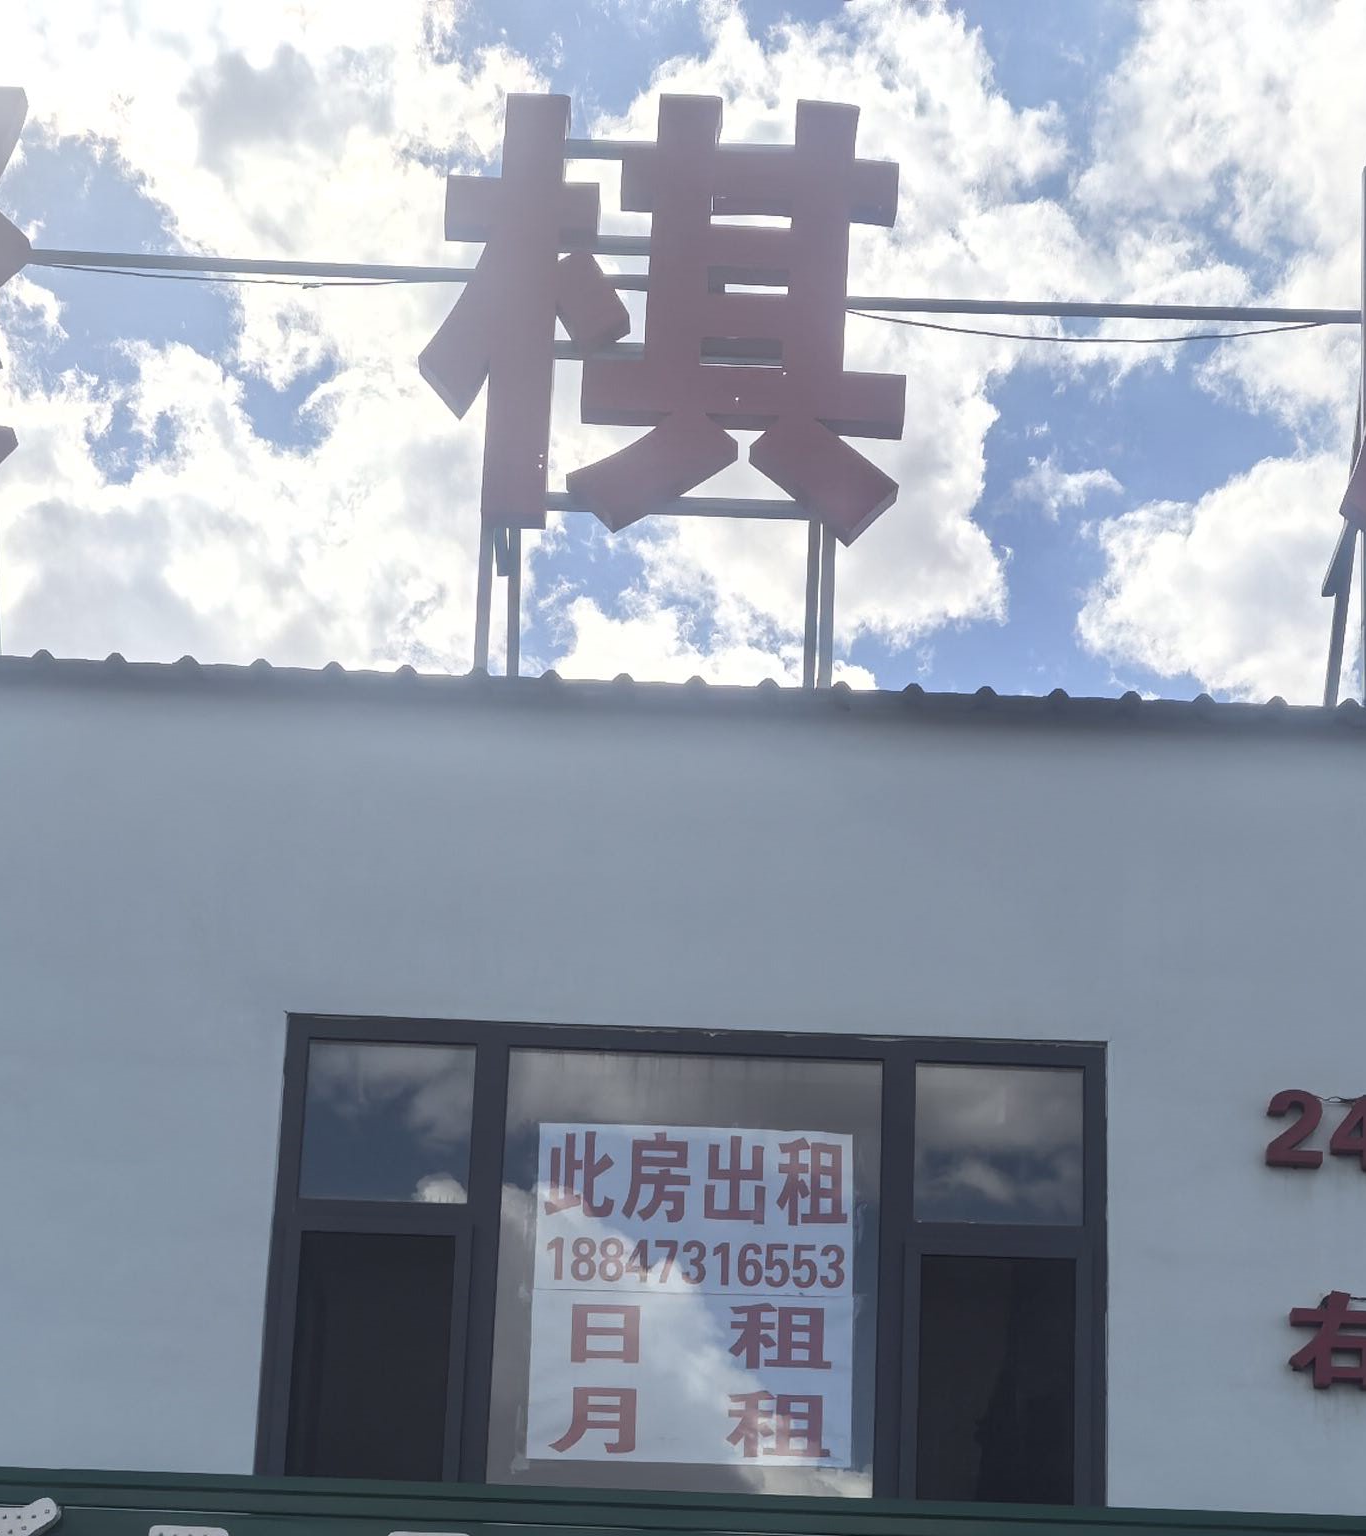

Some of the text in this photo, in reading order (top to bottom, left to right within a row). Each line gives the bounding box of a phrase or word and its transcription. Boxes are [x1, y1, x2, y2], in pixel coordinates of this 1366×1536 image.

[545, 1131, 848, 1226] 此房出租
[547, 1237, 846, 1288] 18847316553
